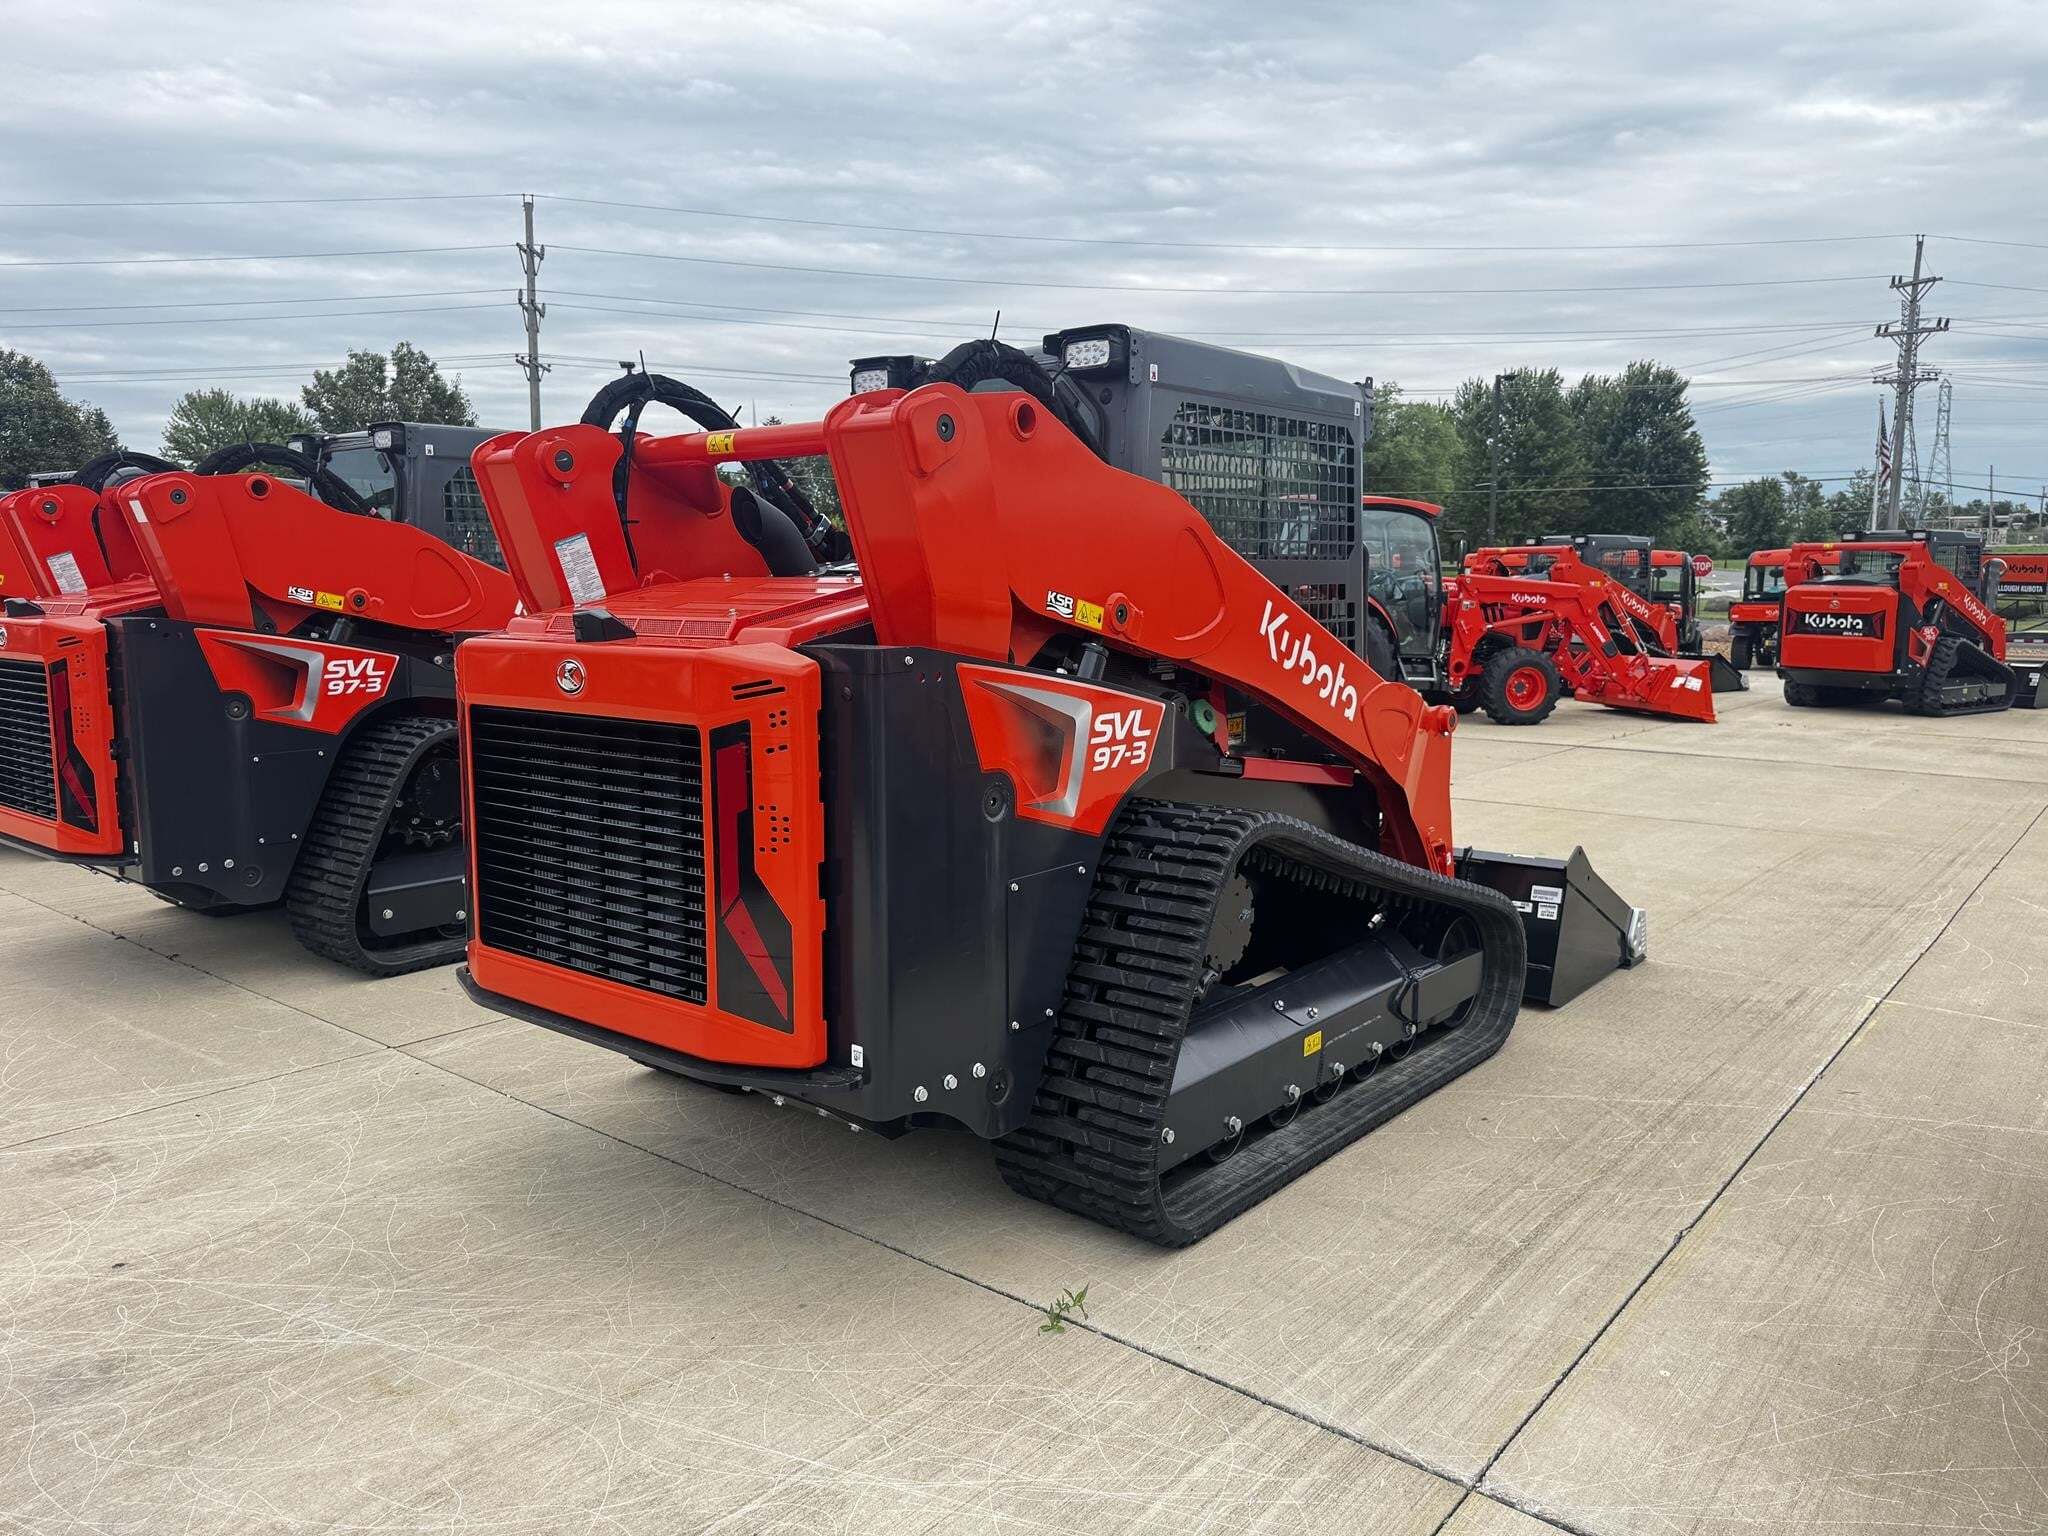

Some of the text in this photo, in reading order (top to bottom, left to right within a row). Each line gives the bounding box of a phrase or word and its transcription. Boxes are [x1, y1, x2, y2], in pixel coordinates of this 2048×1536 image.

[2008, 564, 2044, 574] Kubota
[288, 586, 314, 600] KSR
[1511, 593, 1547, 604] Kubota
[2020, 585, 2043, 593] KUBOTA
[1047, 591, 1074, 610] KSR
[1621, 590, 1649, 618] Kubota
[1963, 594, 1988, 625] Kubota
[1804, 613, 1863, 630] Kubota
[323, 658, 386, 679] SVL
[1260, 600, 1358, 722] Kubota
[327, 678, 382, 695] 97-3
[1091, 709, 1151, 745] SVL
[1093, 741, 1147, 771] 97-3
